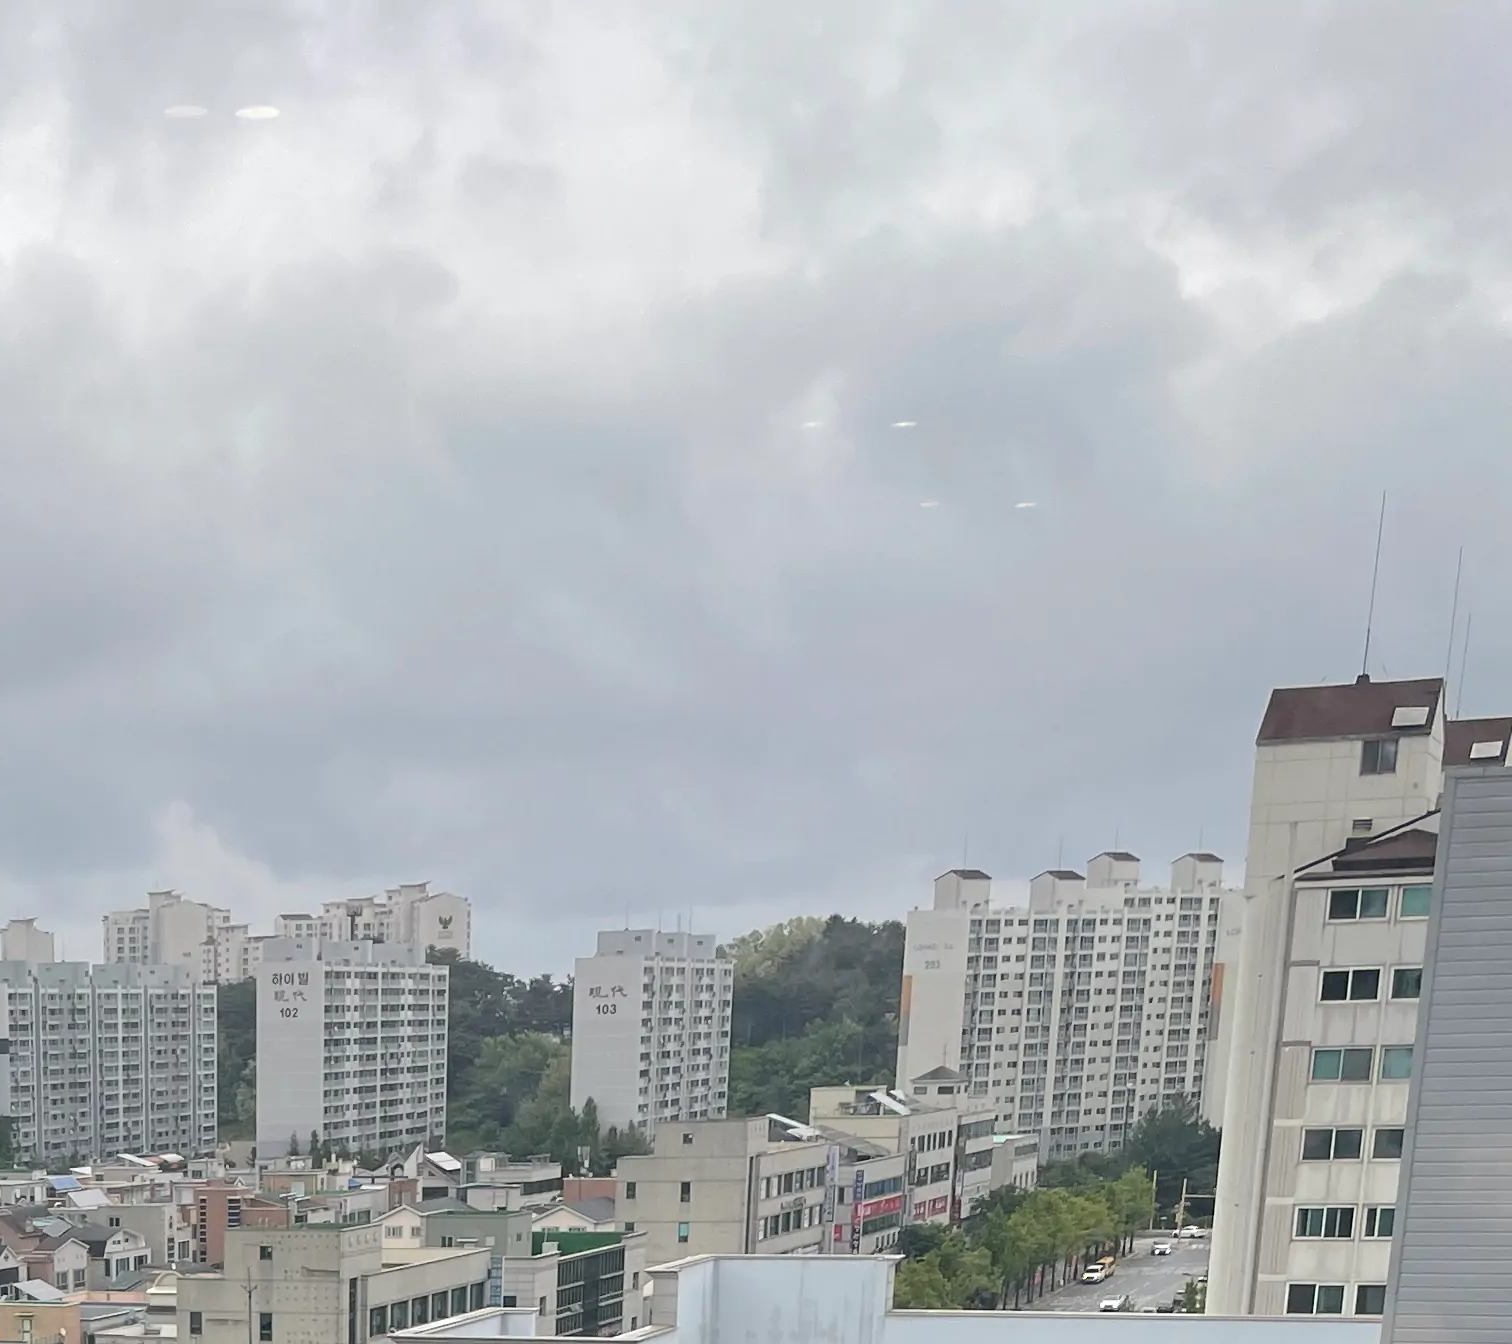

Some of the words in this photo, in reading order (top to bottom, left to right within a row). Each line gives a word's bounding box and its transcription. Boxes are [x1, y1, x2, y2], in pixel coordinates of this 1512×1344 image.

[272, 972, 309, 986] 하이빌
[279, 1007, 299, 1018] 102
[595, 1004, 617, 1015] 103
